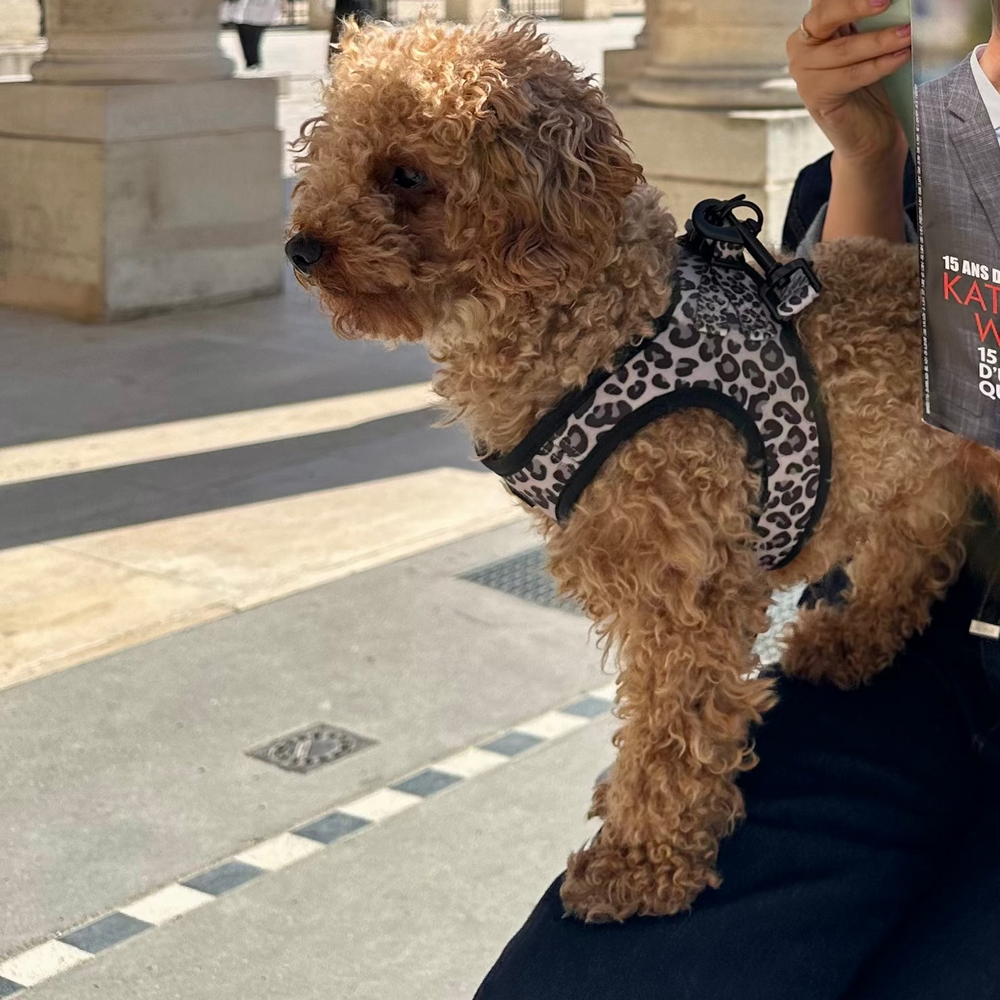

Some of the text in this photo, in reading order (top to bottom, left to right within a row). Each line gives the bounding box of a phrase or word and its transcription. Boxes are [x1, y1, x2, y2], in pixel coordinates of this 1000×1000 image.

[942, 255, 959, 272] 15
[962, 259, 990, 281] ANS
[978, 347, 997, 365] 15
